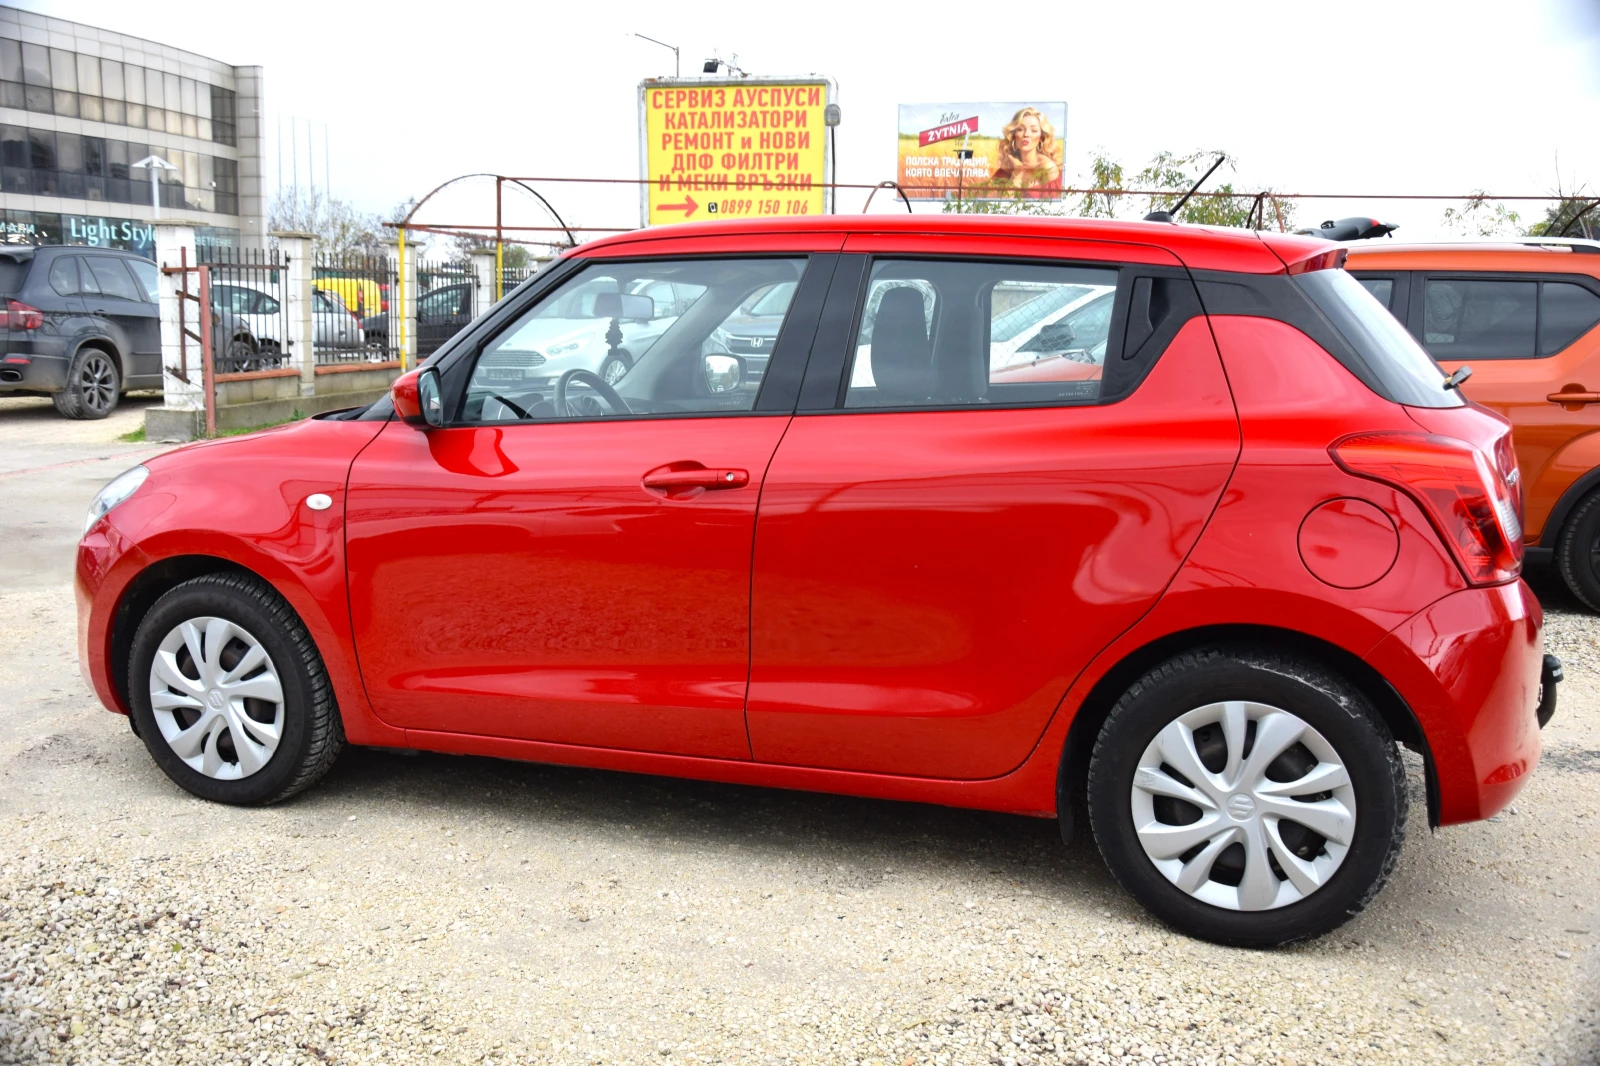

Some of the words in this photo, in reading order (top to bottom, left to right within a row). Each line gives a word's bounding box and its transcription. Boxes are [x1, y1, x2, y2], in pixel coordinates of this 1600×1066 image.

[652, 88, 726, 109] СЕРВИЗ
[732, 87, 820, 108] АУСПУСИ
[665, 110, 807, 130] КАТАЛИЗАТОРИ
[662, 132, 735, 151] РЕМОНТ
[740, 136, 752, 149] и
[759, 131, 810, 149] НОВИ
[671, 153, 714, 173] ДПФ
[721, 152, 799, 171] ФИЛТРИ
[905, 156, 939, 167] ПОЛСКА
[659, 174, 670, 192] И
[678, 174, 728, 191] МЕКИ
[735, 173, 812, 191] ВРЪЗКИ
[905, 168, 932, 178] КОЯТО
[721, 200, 752, 215] 0899
[758, 200, 780, 215] 150
[786, 200, 808, 215] 106
[70, 217, 118, 247] Light
